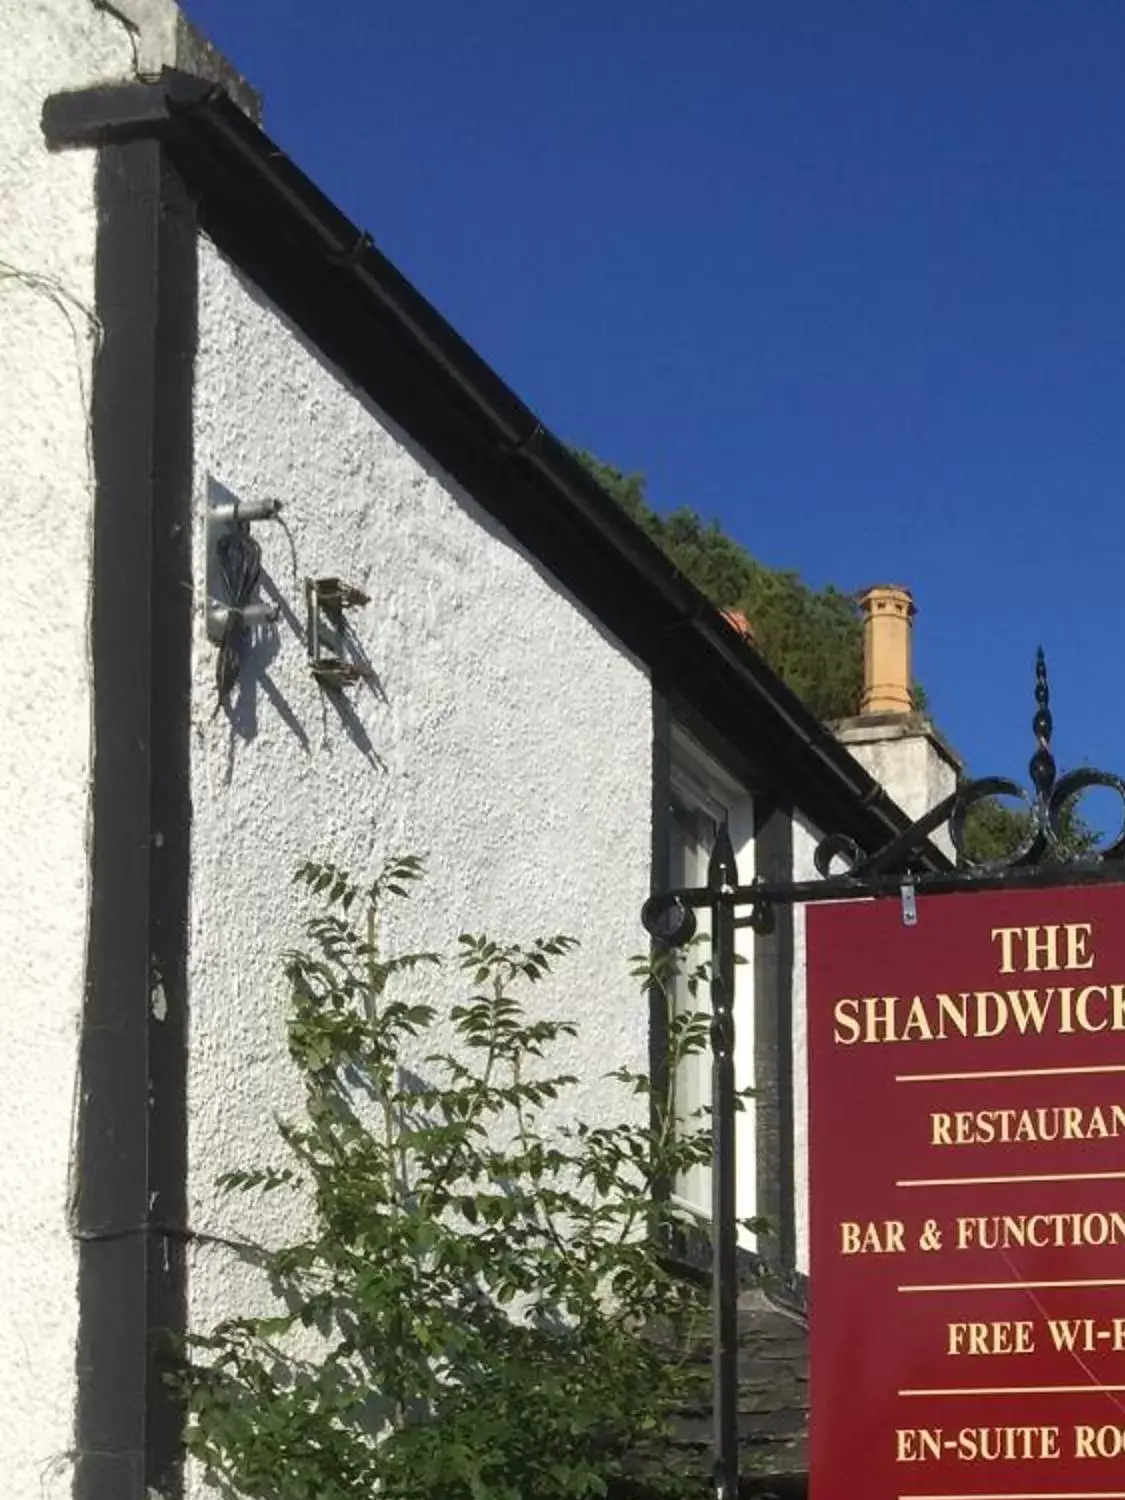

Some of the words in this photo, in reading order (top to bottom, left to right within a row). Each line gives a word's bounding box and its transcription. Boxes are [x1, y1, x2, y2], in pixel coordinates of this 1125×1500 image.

[992, 924, 1094, 972] THE
[841, 1221, 905, 1253] BAR
[920, 1220, 942, 1250] &
[948, 1322, 1034, 1354] FREE
[896, 1427, 1060, 1460] EN-SUITE
